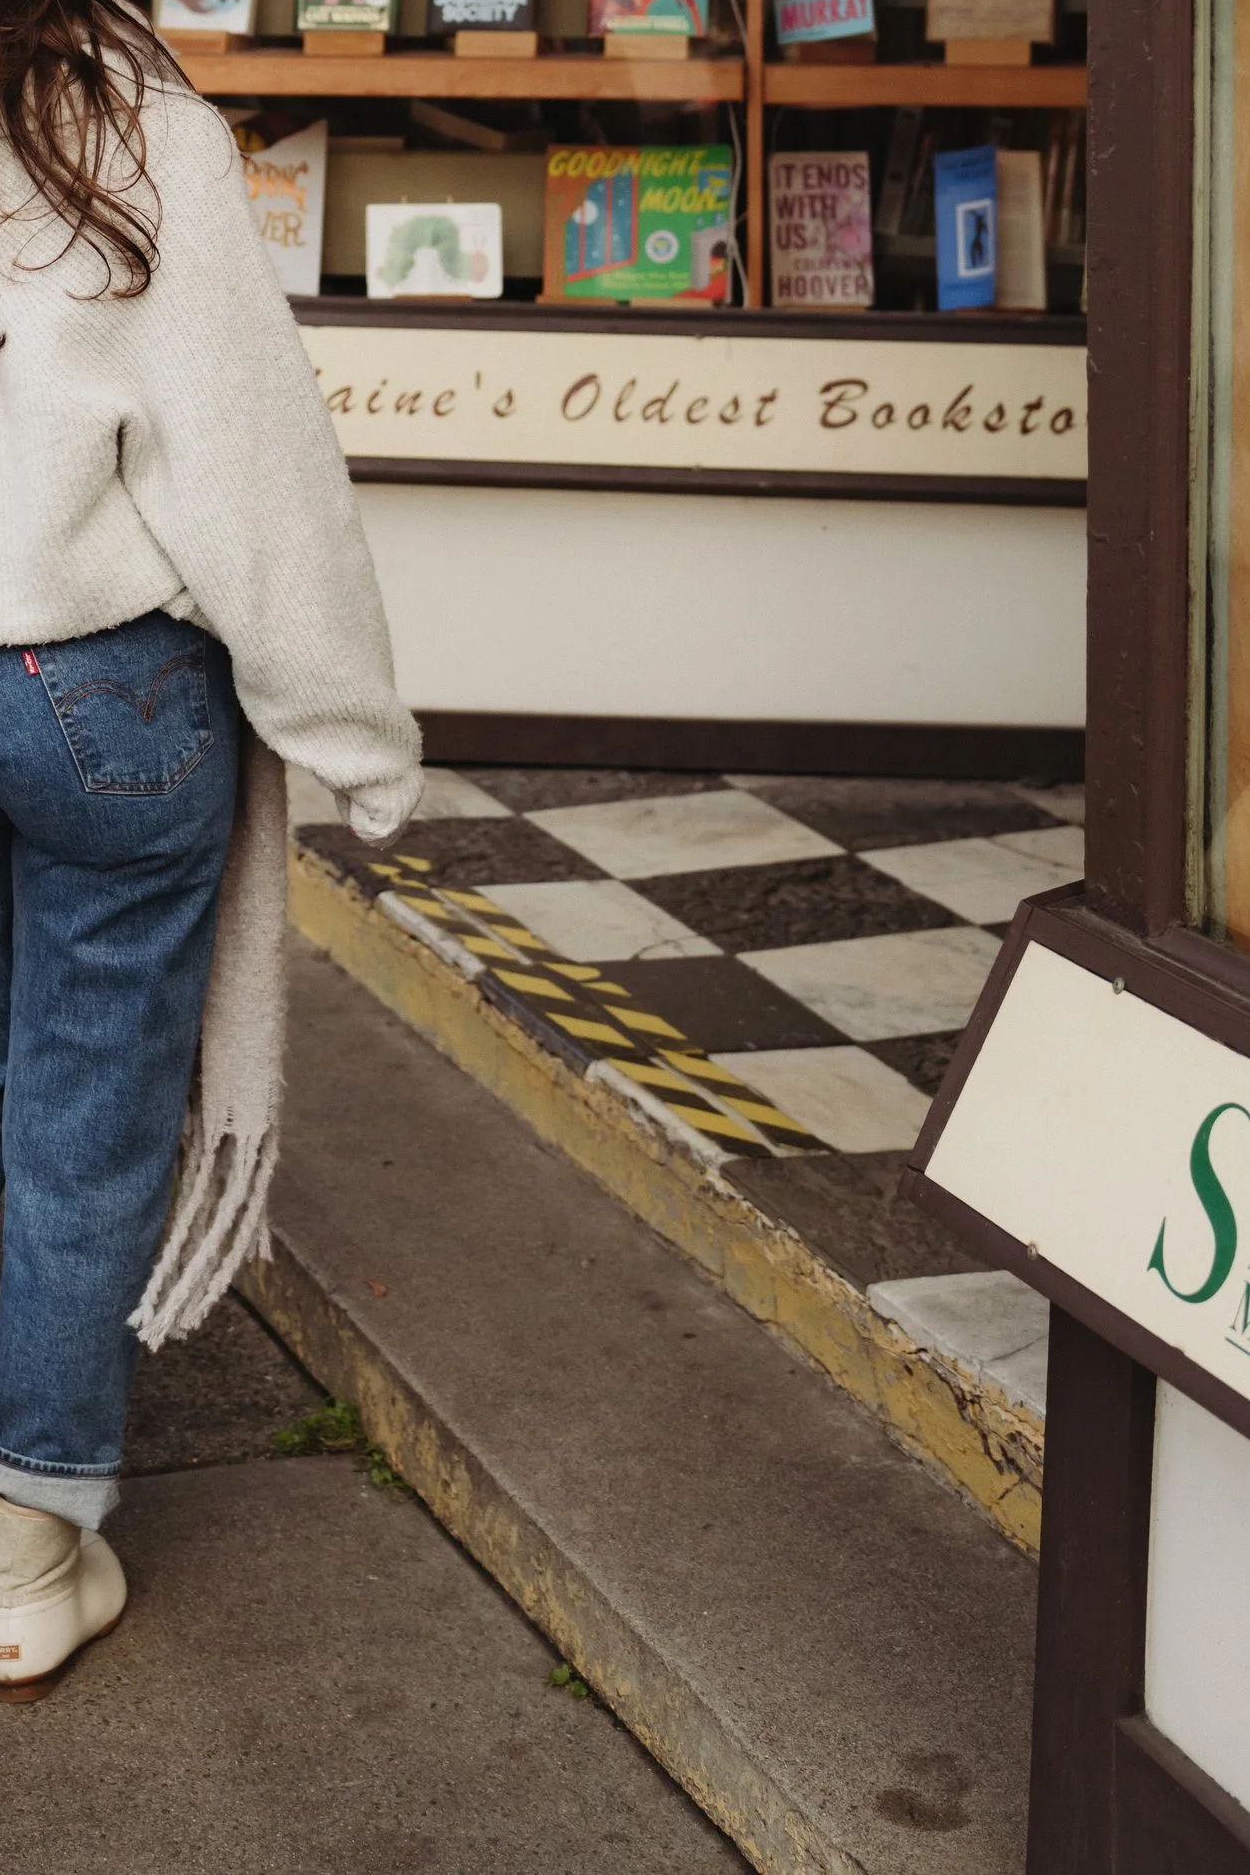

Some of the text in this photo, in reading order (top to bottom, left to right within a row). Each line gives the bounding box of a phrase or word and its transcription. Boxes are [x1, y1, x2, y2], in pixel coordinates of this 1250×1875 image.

[548, 149, 708, 179] GOODNIGHT
[776, 163, 867, 191] IT ENDS
[639, 185, 717, 214] MOON
[776, 194, 837, 221] WITH
[777, 222, 807, 251] US
[777, 275, 869, 299] HOOVER
[315, 369, 1076, 436] aine's Oldest Booksto
[1148, 1102, 1250, 1304] S
